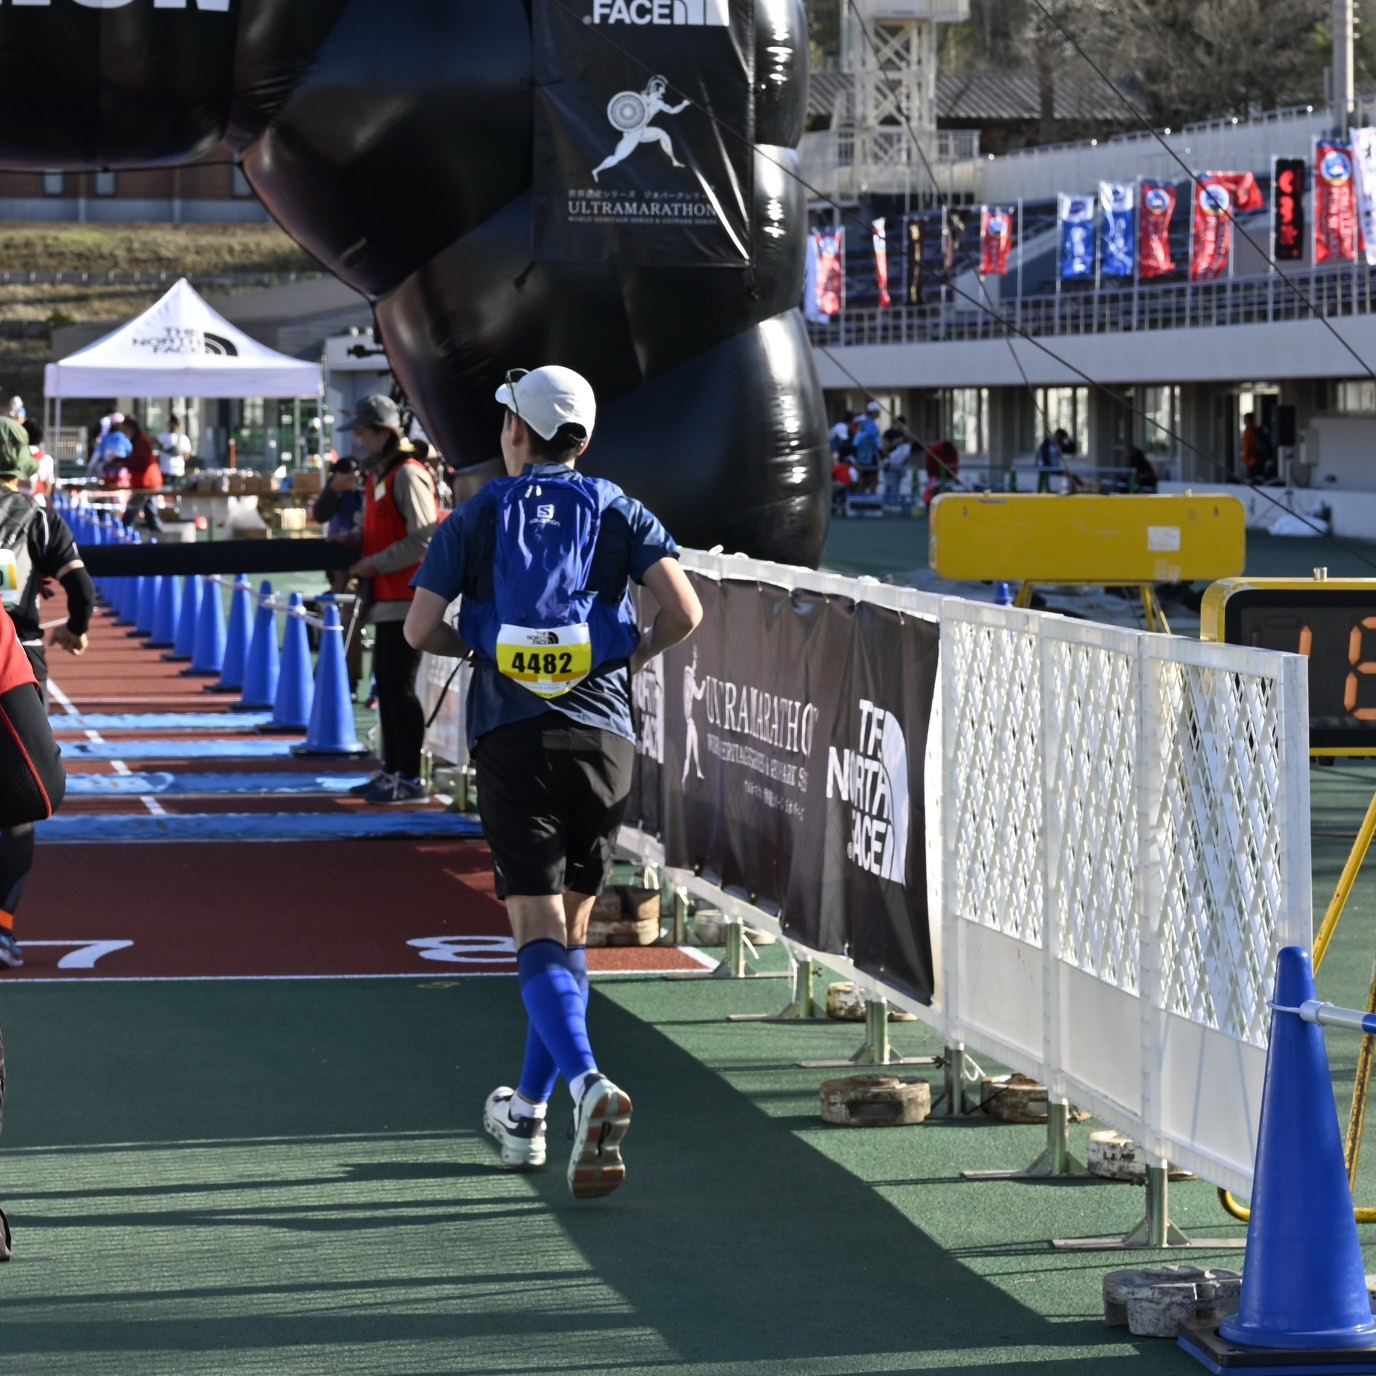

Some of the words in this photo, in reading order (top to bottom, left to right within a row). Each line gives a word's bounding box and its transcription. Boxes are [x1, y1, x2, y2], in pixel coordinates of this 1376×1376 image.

[567, 200, 719, 217] ULTRAMARATHON
[512, 652, 572, 674] 4482
[16, 939, 135, 969] 7
